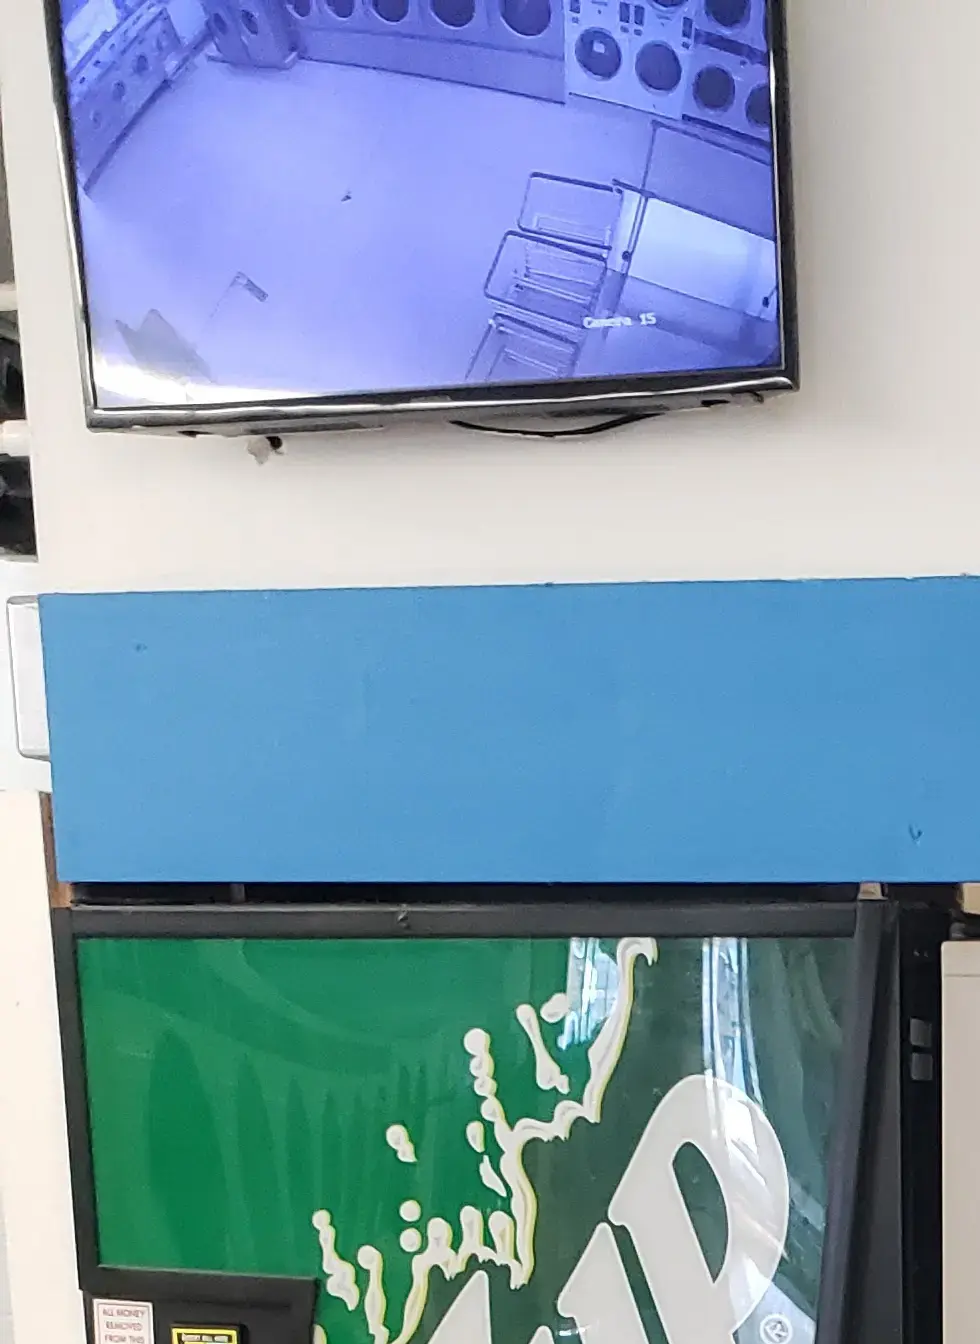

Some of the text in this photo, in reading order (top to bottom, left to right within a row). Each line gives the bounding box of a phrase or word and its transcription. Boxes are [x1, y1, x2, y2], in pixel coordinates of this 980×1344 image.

[640, 313, 656, 325] 15
[116, 1309, 146, 1318] MONEY
[104, 1334, 127, 1343] FROM
